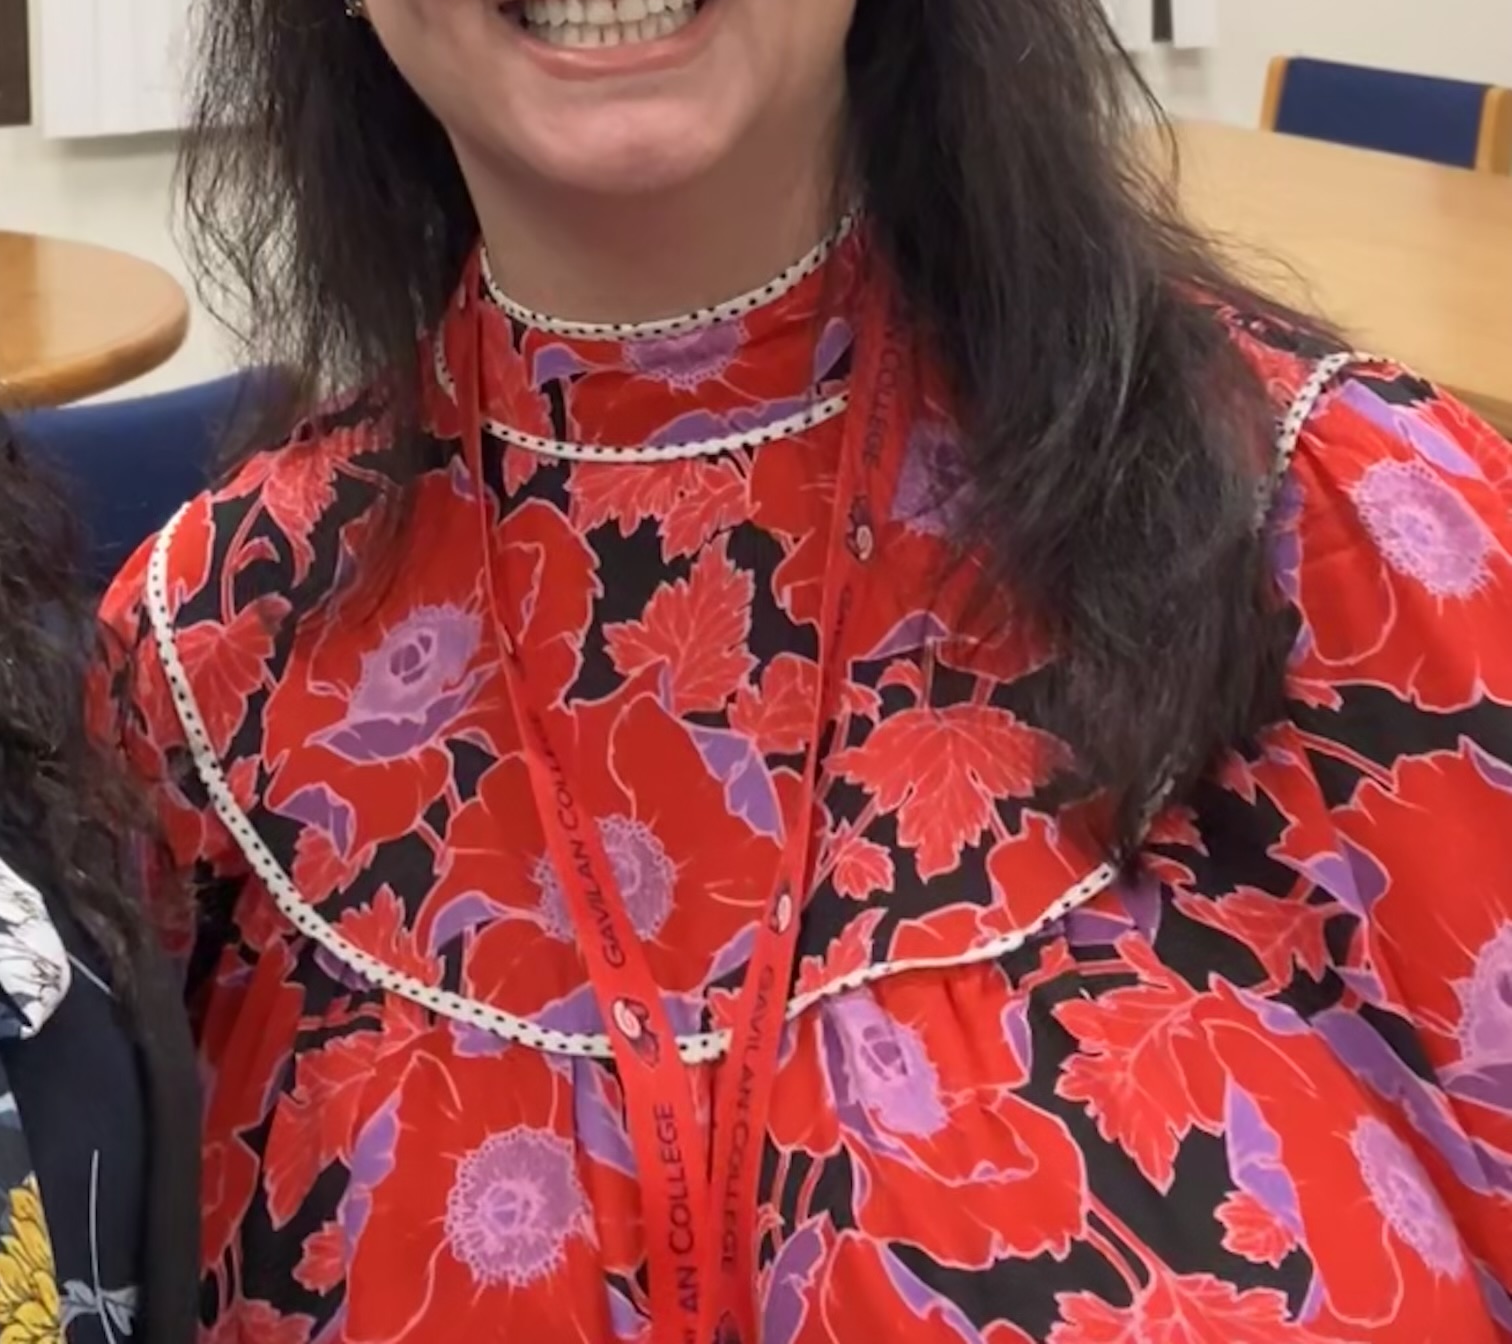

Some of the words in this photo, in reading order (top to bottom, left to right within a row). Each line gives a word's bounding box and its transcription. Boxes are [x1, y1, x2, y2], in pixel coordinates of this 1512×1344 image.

[526, 707, 579, 831] COLL
[569, 839, 626, 969] GAVILAN
[737, 963, 775, 1110] GAVILAN
[653, 1102, 694, 1256] COLLEGE
